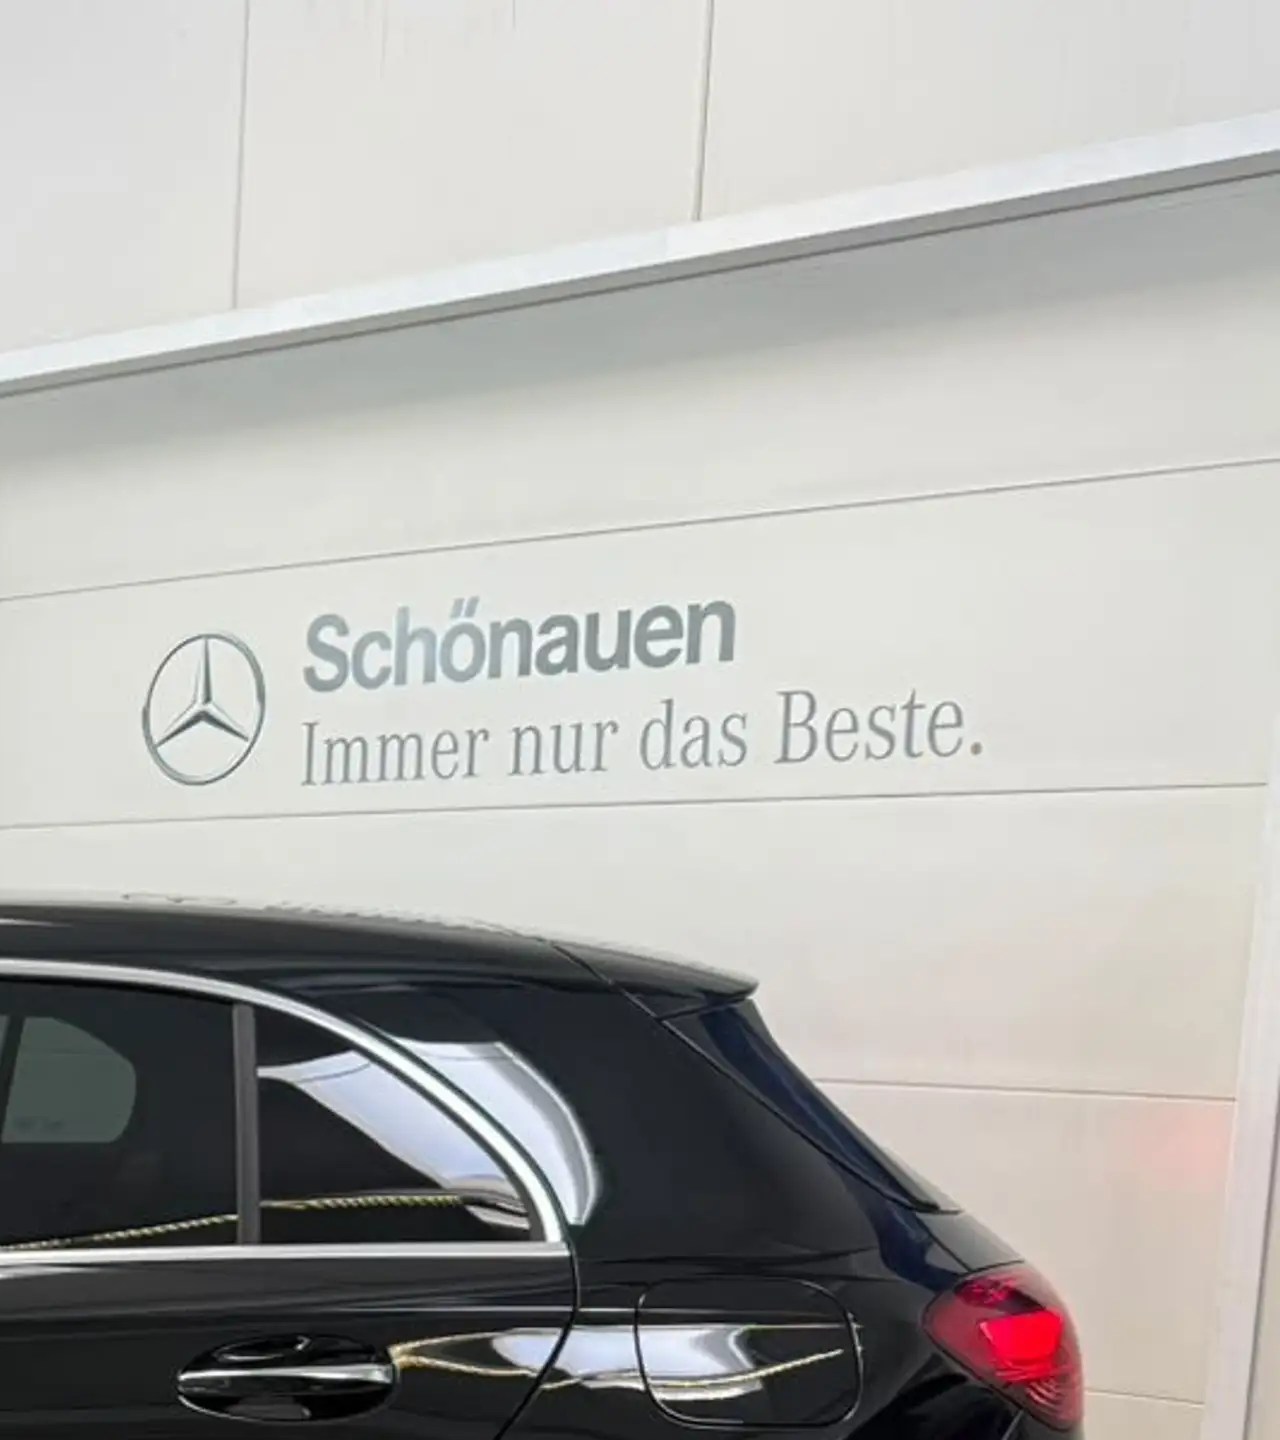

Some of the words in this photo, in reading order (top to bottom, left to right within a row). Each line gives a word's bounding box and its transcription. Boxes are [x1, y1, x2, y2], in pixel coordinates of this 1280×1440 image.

[303, 596, 736, 693] Schönauen
[300, 721, 489, 786] Immer
[507, 721, 620, 776] nur
[639, 698, 748, 771] das
[773, 688, 983, 764] Beste.
